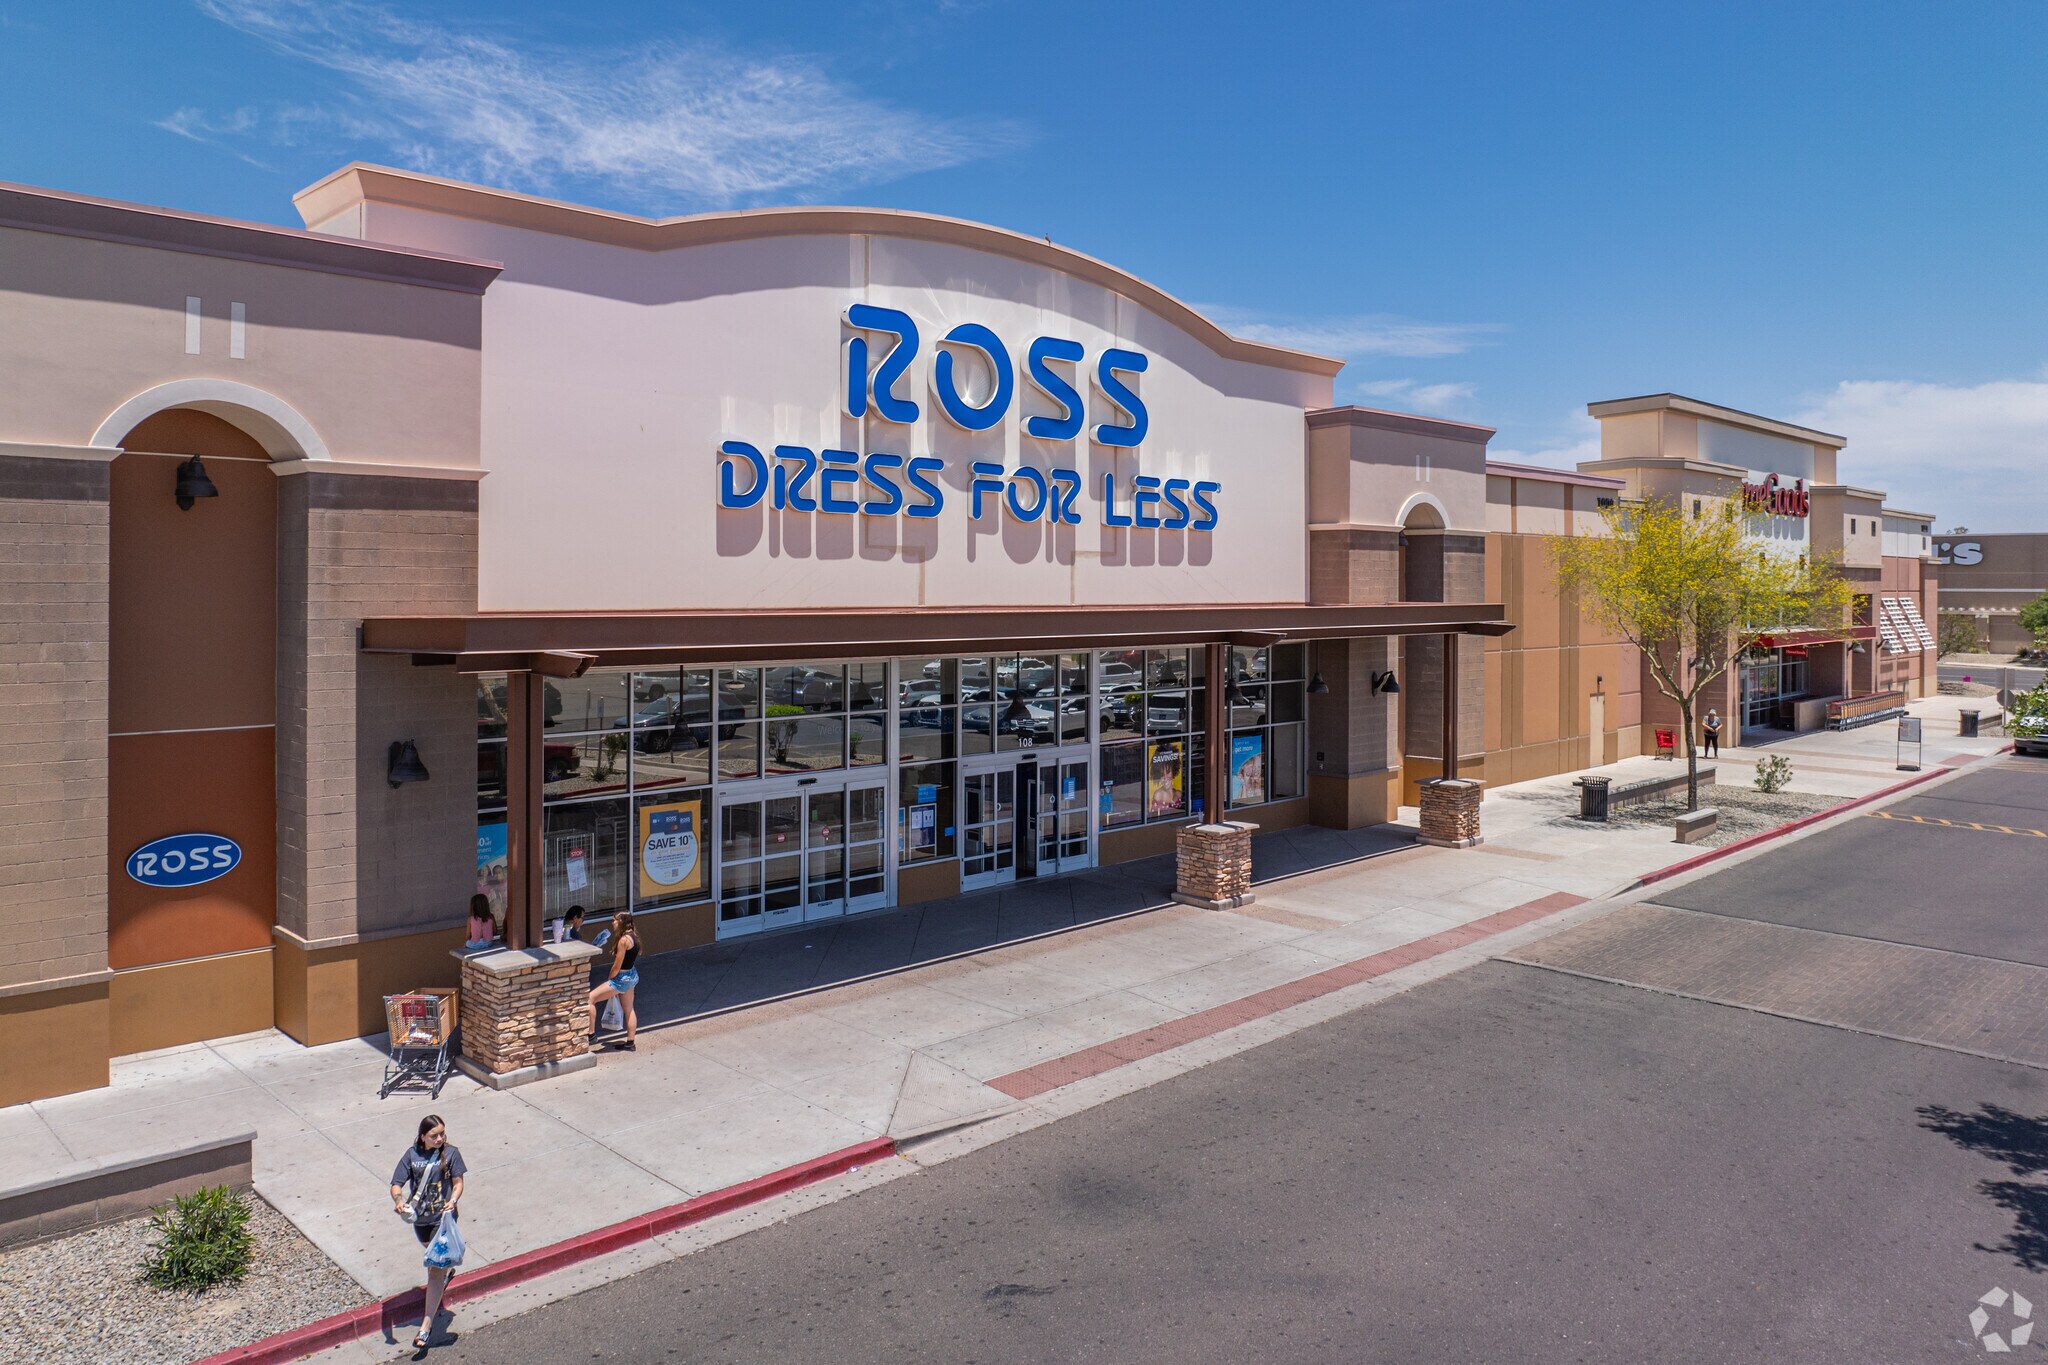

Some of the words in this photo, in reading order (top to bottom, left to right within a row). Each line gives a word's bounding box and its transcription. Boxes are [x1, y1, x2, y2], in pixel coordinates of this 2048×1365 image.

[841, 302, 1149, 448] ROSS
[716, 439, 945, 519] DRESS
[967, 460, 1083, 526] FOR
[1100, 471, 1221, 532] LESS
[1018, 737, 1033, 748] 108
[648, 836, 676, 851] SAVE
[136, 844, 232, 877] ROSS
